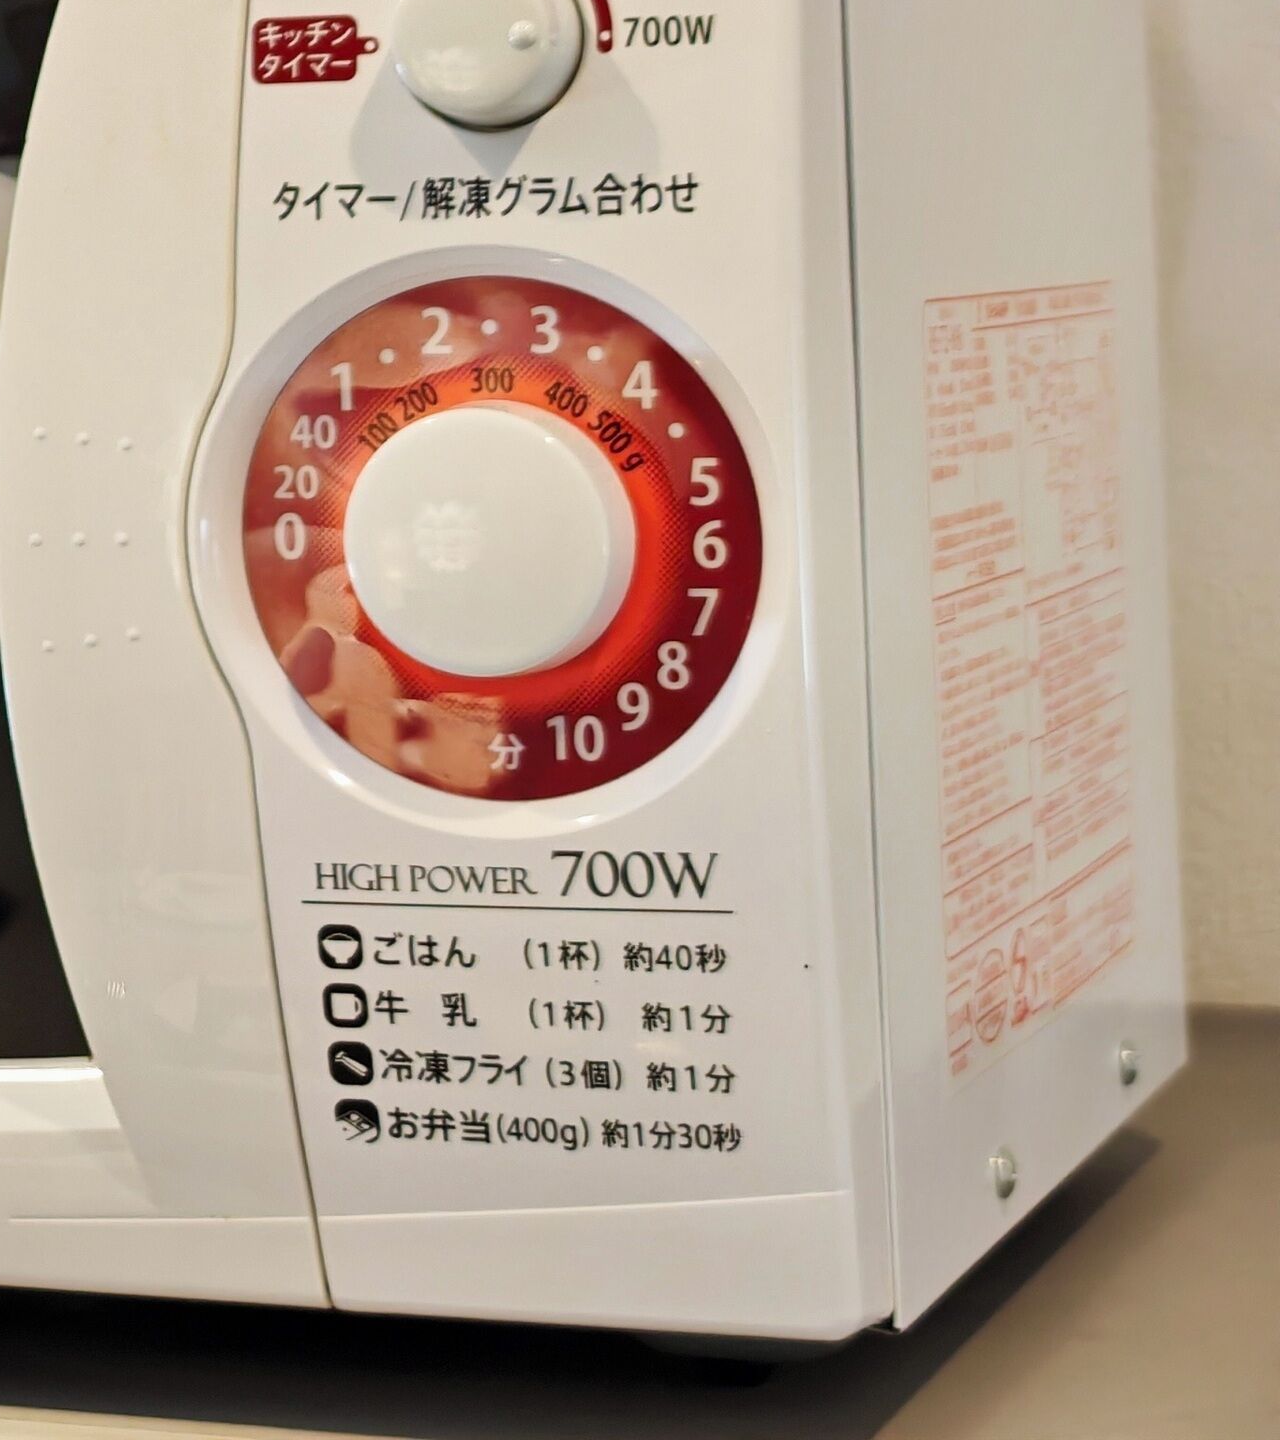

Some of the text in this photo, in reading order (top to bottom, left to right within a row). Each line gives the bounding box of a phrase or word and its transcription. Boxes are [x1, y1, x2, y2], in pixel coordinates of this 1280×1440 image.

[258, 20, 354, 48] キッチン
[623, 14, 714, 47] 700W
[258, 54, 354, 80] タイマー
[272, 172, 699, 222] タイマー/解凍グラム合わせ
[358, 412, 398, 453] 100
[395, 383, 438, 424] 200
[471, 368, 514, 393] 300
[544, 381, 589, 417] 400
[274, 305, 727, 771] 0 20 40 1 2 3 4 5 6 7 8 9 10 分
[314, 851, 718, 899] HIGH POWER 700W
[373, 932, 477, 967] ごはん
[623, 942, 726, 973] 約40秒
[643, 1002, 731, 1034] 約1分
[380, 1050, 528, 1087] 冷凍フライ
[647, 1062, 736, 1093] 約1分
[602, 1119, 743, 1152] 約1分30秒
